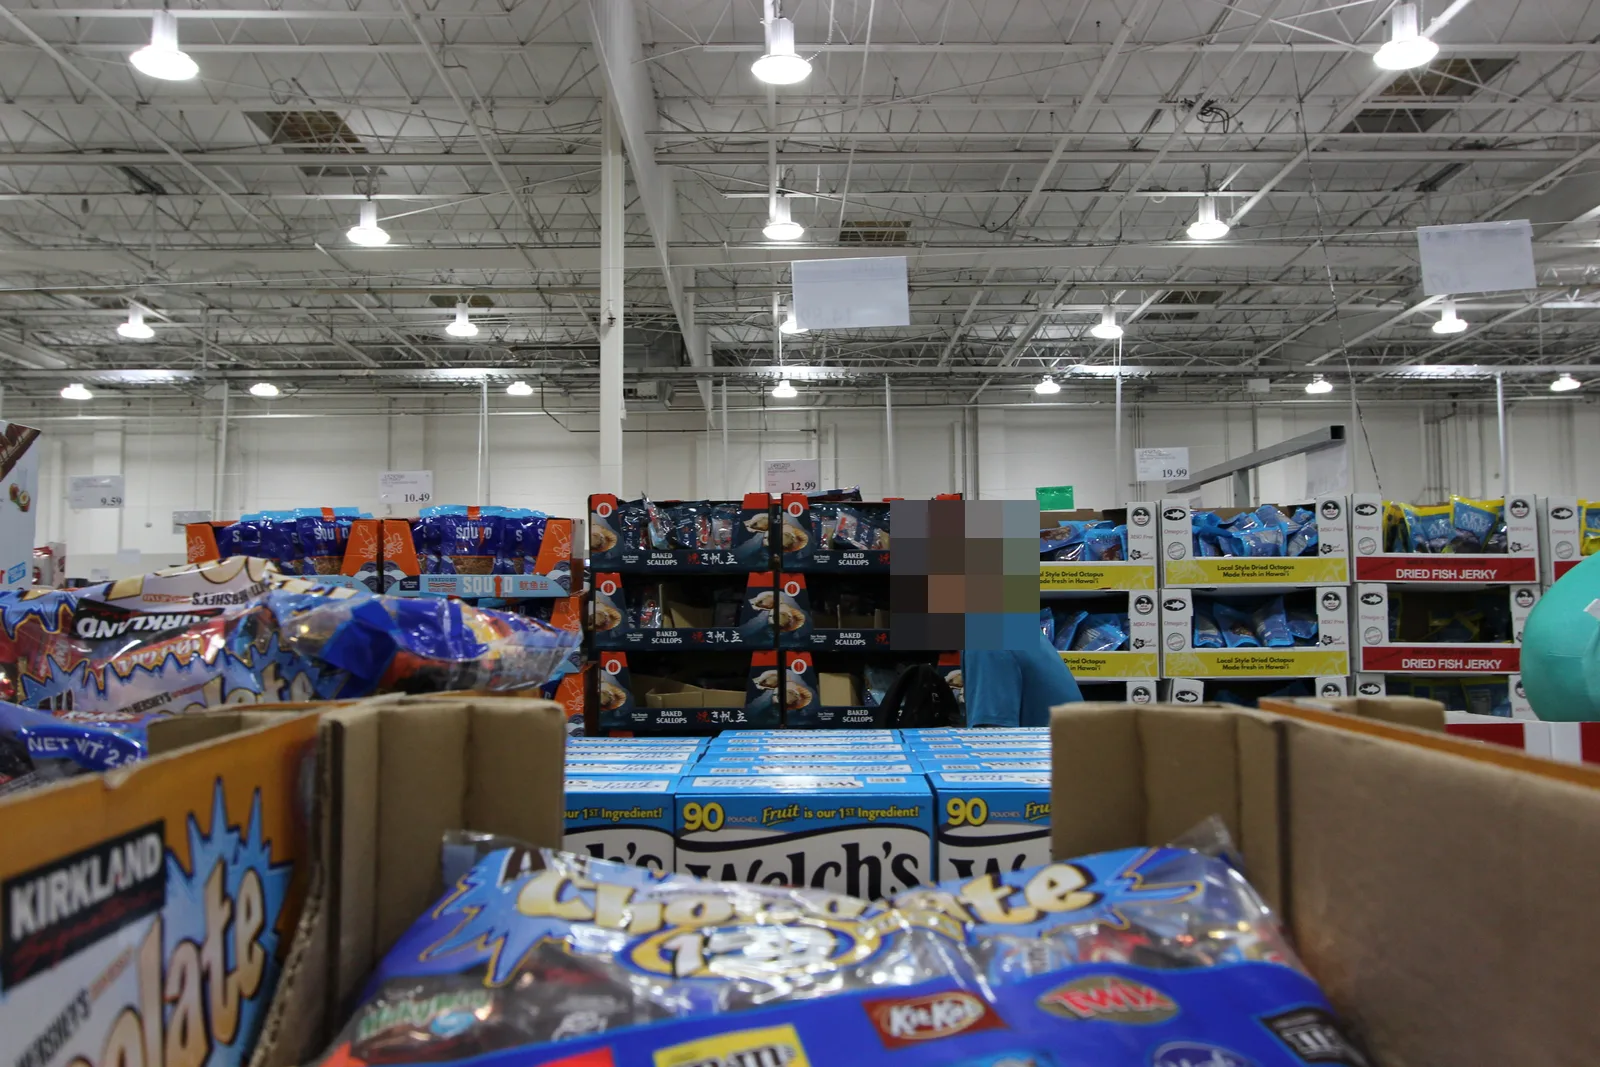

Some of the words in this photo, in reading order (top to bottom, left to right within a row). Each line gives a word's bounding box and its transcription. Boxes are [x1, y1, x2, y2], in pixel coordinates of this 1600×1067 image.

[1163, 468, 1187, 478] 19.99
[791, 481, 816, 491] 12.99
[405, 493, 430, 503] 10.49
[1079, 571, 1104, 579] Octopus
[1396, 569, 1430, 579] DRIED
[1432, 569, 1457, 579] FISH
[1459, 569, 1497, 579] JERKY
[463, 576, 513, 597] SQUID
[1401, 659, 1437, 669] DRIED
[1438, 659, 1463, 669] FISH
[1464, 659, 1502, 669] JERKY
[28, 737, 69, 752] NET
[74, 738, 104, 759] WT
[601, 807, 663, 822] Ingredient!
[683, 802, 725, 832] 90
[727, 815, 758, 823] POUCHES
[761, 804, 800, 824] Fruit
[804, 807, 813, 819] is
[816, 810, 836, 819] our
[839, 807, 856, 819] 1ST
[858, 805, 919, 821] Ingredient!
[946, 797, 988, 827] 90
[10, 832, 162, 941] KIRKLAND
[516, 862, 1101, 937] Choote
